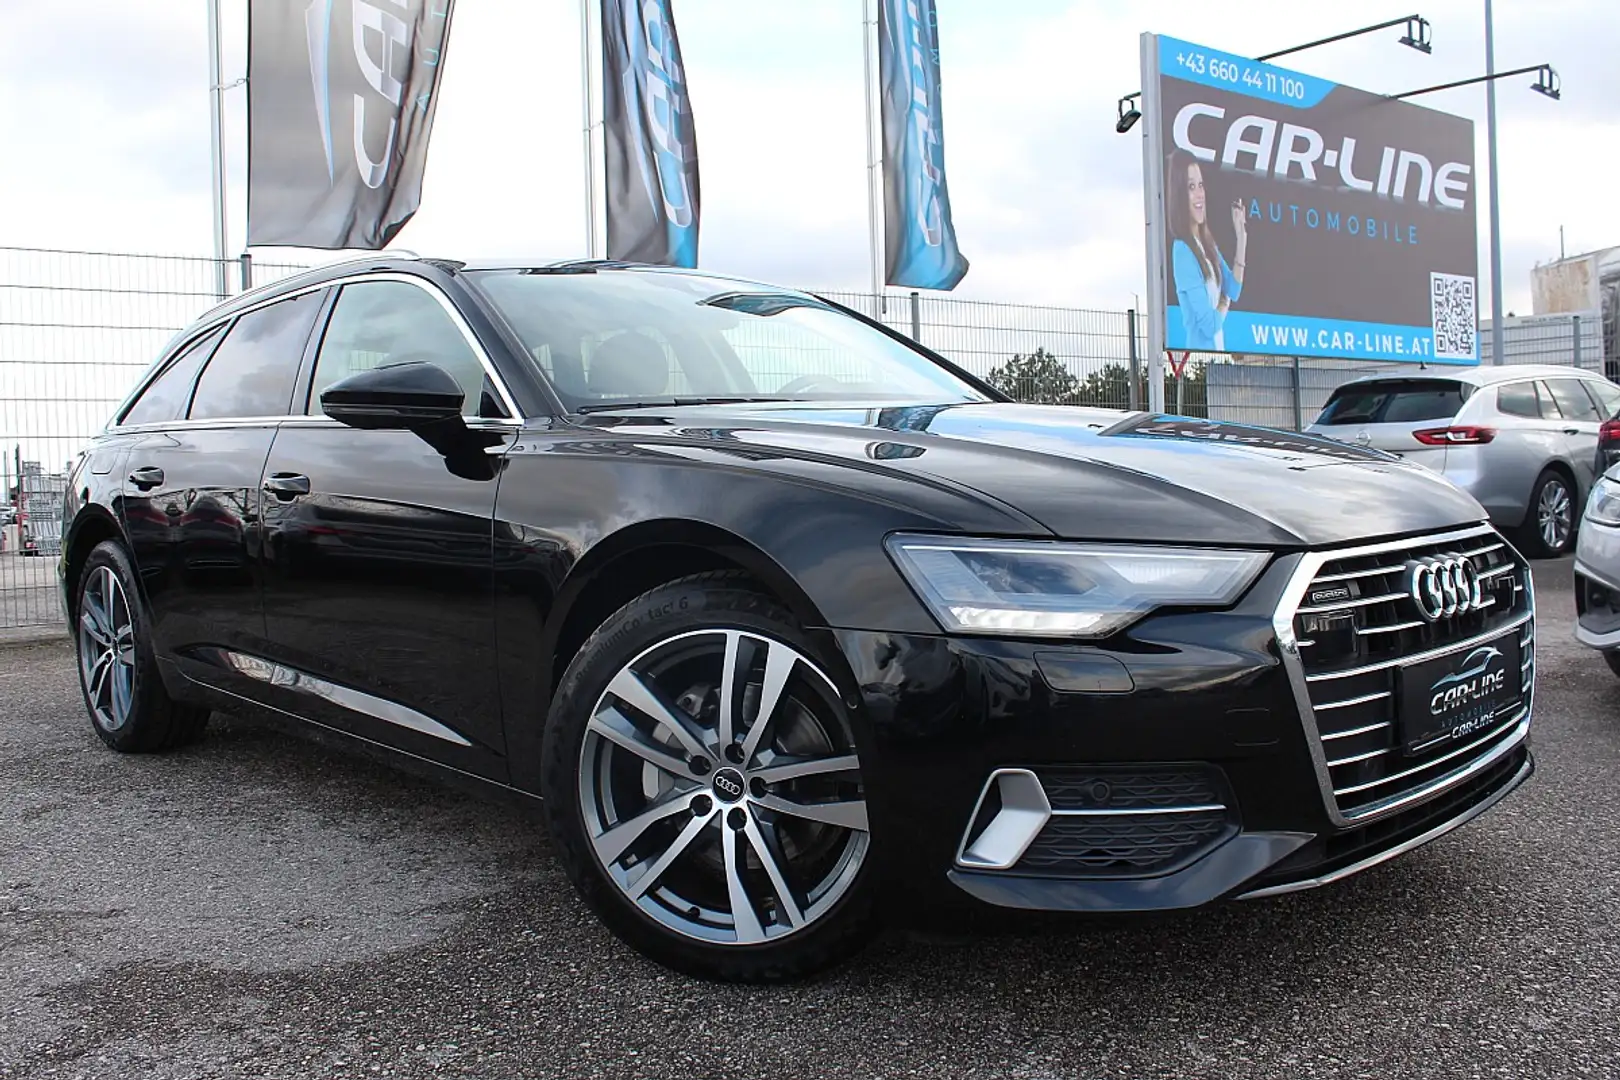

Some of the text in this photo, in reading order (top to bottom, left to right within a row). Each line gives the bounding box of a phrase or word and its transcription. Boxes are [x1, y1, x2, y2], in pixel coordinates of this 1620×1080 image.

[1177, 52, 1304, 99] +43 660 44 11 100
[1250, 198, 1418, 244] AUTOMOBILE
[1252, 324, 1430, 356] WWW.CAR-LINE.AT
[1314, 588, 1348, 601] quattro
[1430, 669, 1504, 715] CAR-LINE
